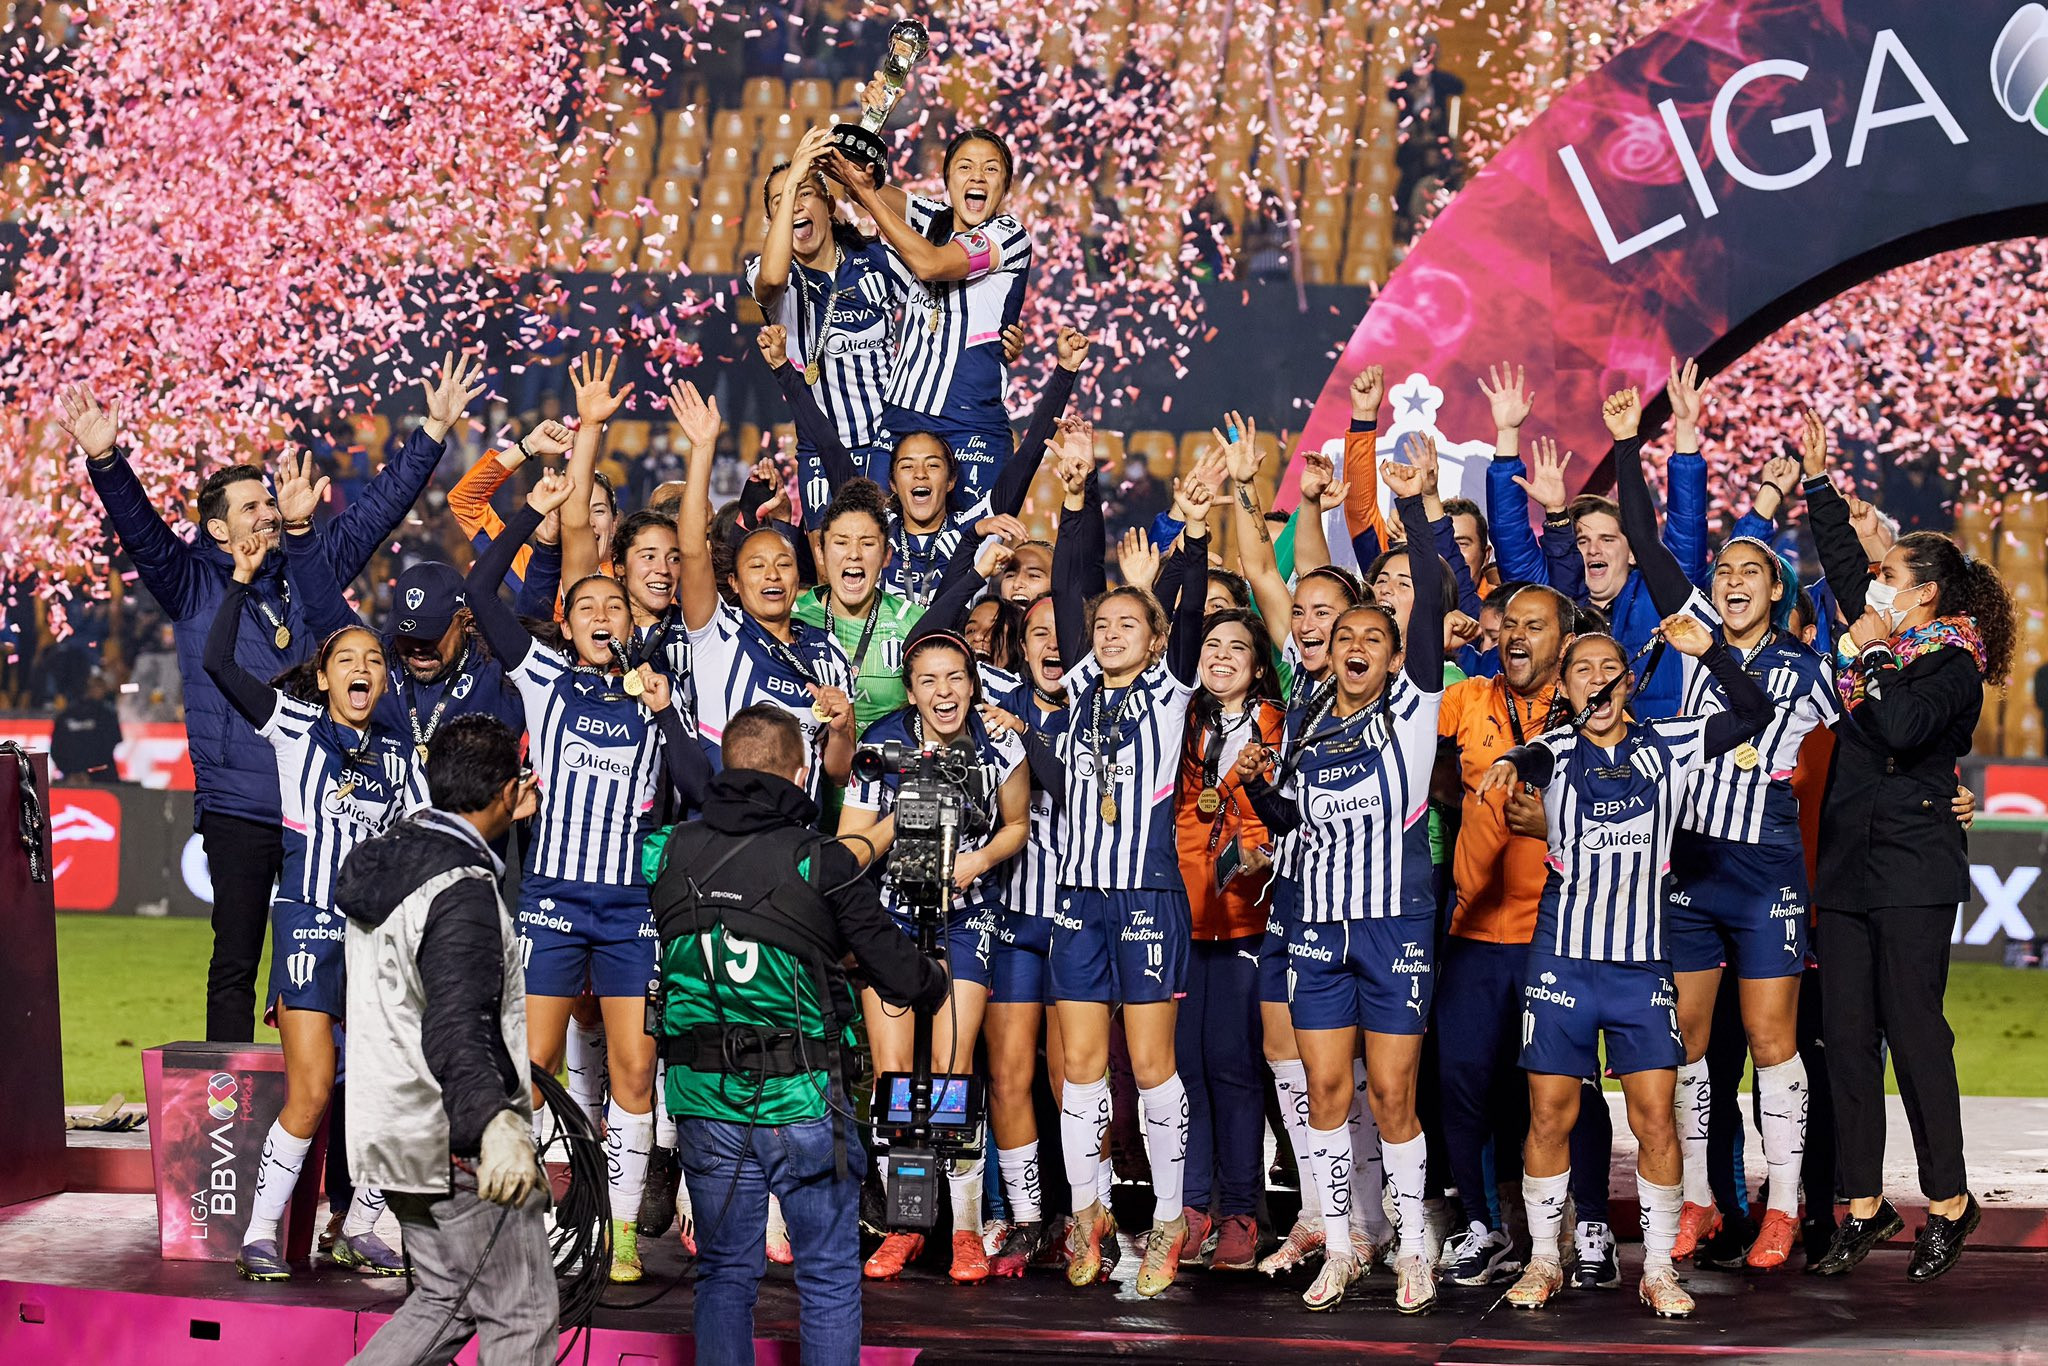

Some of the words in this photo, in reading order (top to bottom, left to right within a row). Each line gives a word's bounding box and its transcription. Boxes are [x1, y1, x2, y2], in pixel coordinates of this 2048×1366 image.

[1557, 28, 1970, 264] LIGA
[831, 308, 877, 323] BBVA
[967, 435, 987, 449] Tim
[954, 448, 995, 464] Hortons
[969, 464, 979, 485] 4
[766, 675, 812, 698] BBV
[574, 715, 631, 740] BBVA
[571, 745, 631, 777] Midea
[341, 769, 384, 797] BBVA
[1318, 762, 1367, 784] BBVA
[1318, 793, 1381, 819] Midea
[1592, 796, 1645, 817] BBVA
[1592, 828, 1652, 848] Midea
[710, 890, 743, 901] STEADICAM
[1779, 886, 1797, 901] Tim
[518, 908, 573, 934] arabela
[979, 908, 996, 921] Tim
[1130, 910, 1154, 925] Tim
[1769, 903, 1805, 919] Hortons
[1120, 925, 1164, 942] Hortons
[1785, 919, 1796, 941] 19
[976, 930, 991, 954] 20
[1287, 942, 1333, 963] arabela
[1401, 942, 1425, 957] Tim
[1146, 944, 1163, 966] 18
[1391, 957, 1430, 974] Hortons
[1411, 975, 1420, 999] 3
[1524, 984, 1576, 1009] arabela
[190, 1188, 208, 1240] LIGA
[208, 1122, 237, 1215] BBVA
[1325, 1147, 1351, 1218] kotex
